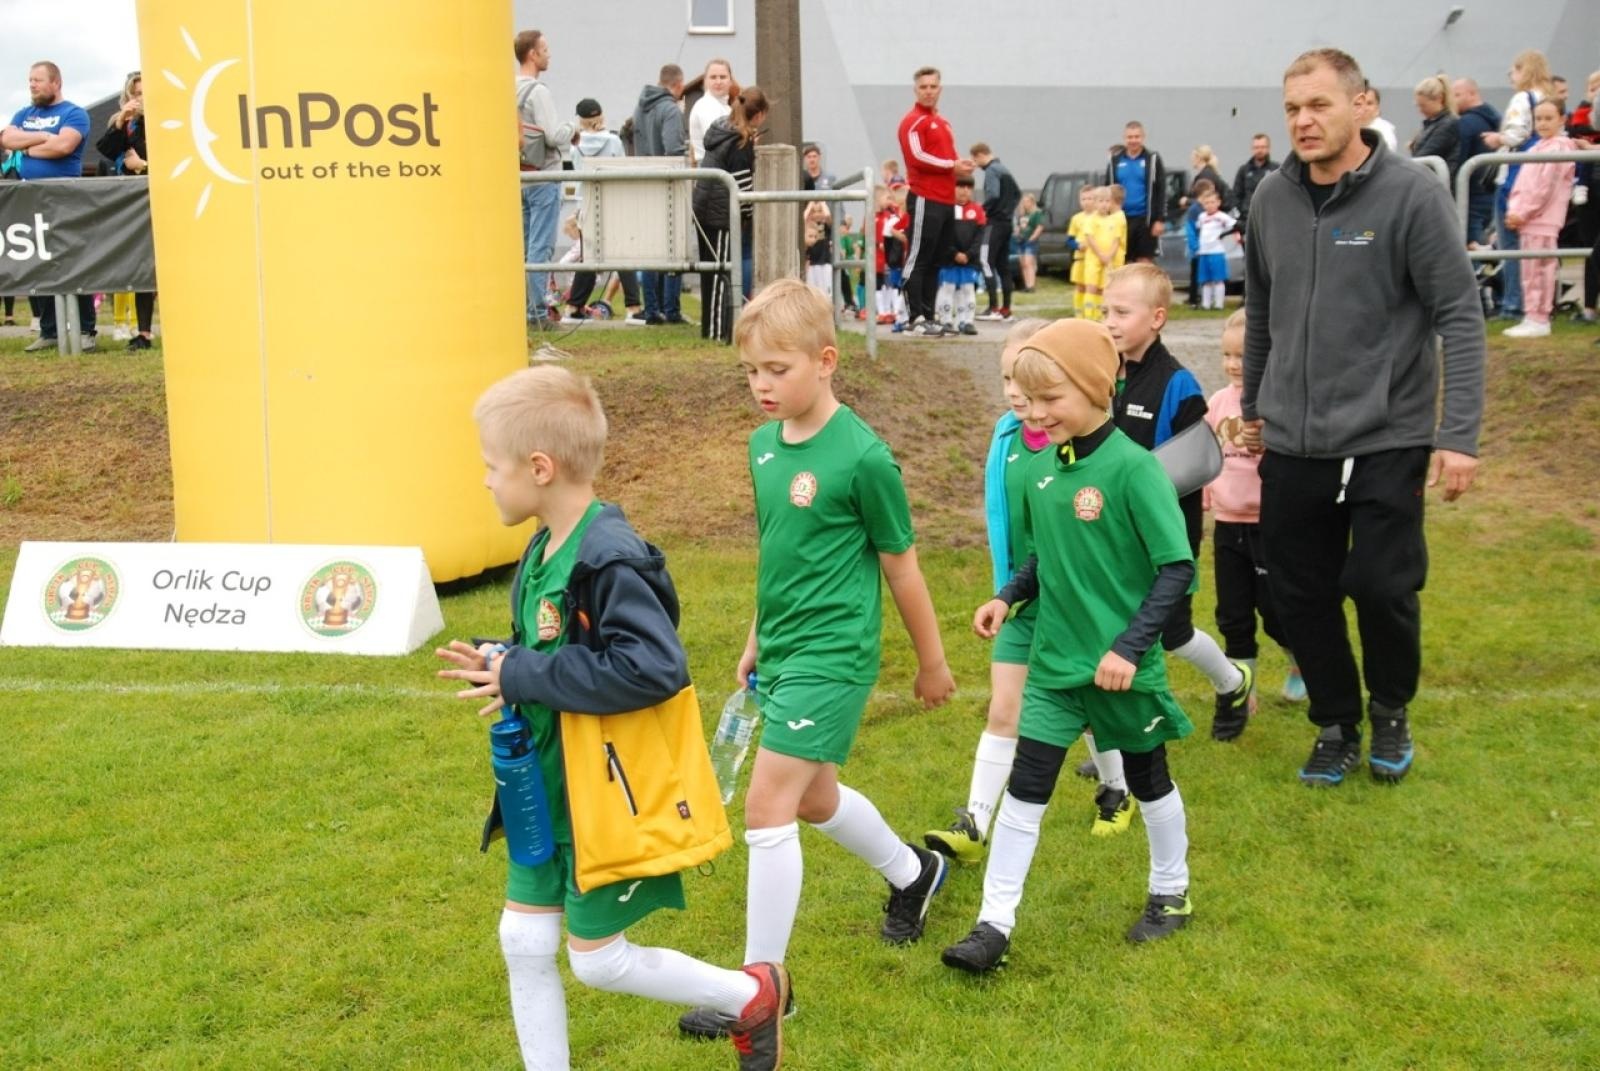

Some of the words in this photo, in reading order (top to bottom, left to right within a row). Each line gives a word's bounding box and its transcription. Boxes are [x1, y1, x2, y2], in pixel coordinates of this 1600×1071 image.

[238, 92, 441, 149] InPost
[260, 163, 304, 180] out
[312, 162, 338, 179] of
[346, 161, 391, 178] the
[399, 160, 442, 177] box
[0, 213, 52, 261] st
[152, 569, 215, 590] Orlik
[221, 570, 272, 597] Cup
[164, 602, 246, 628] Nędza
